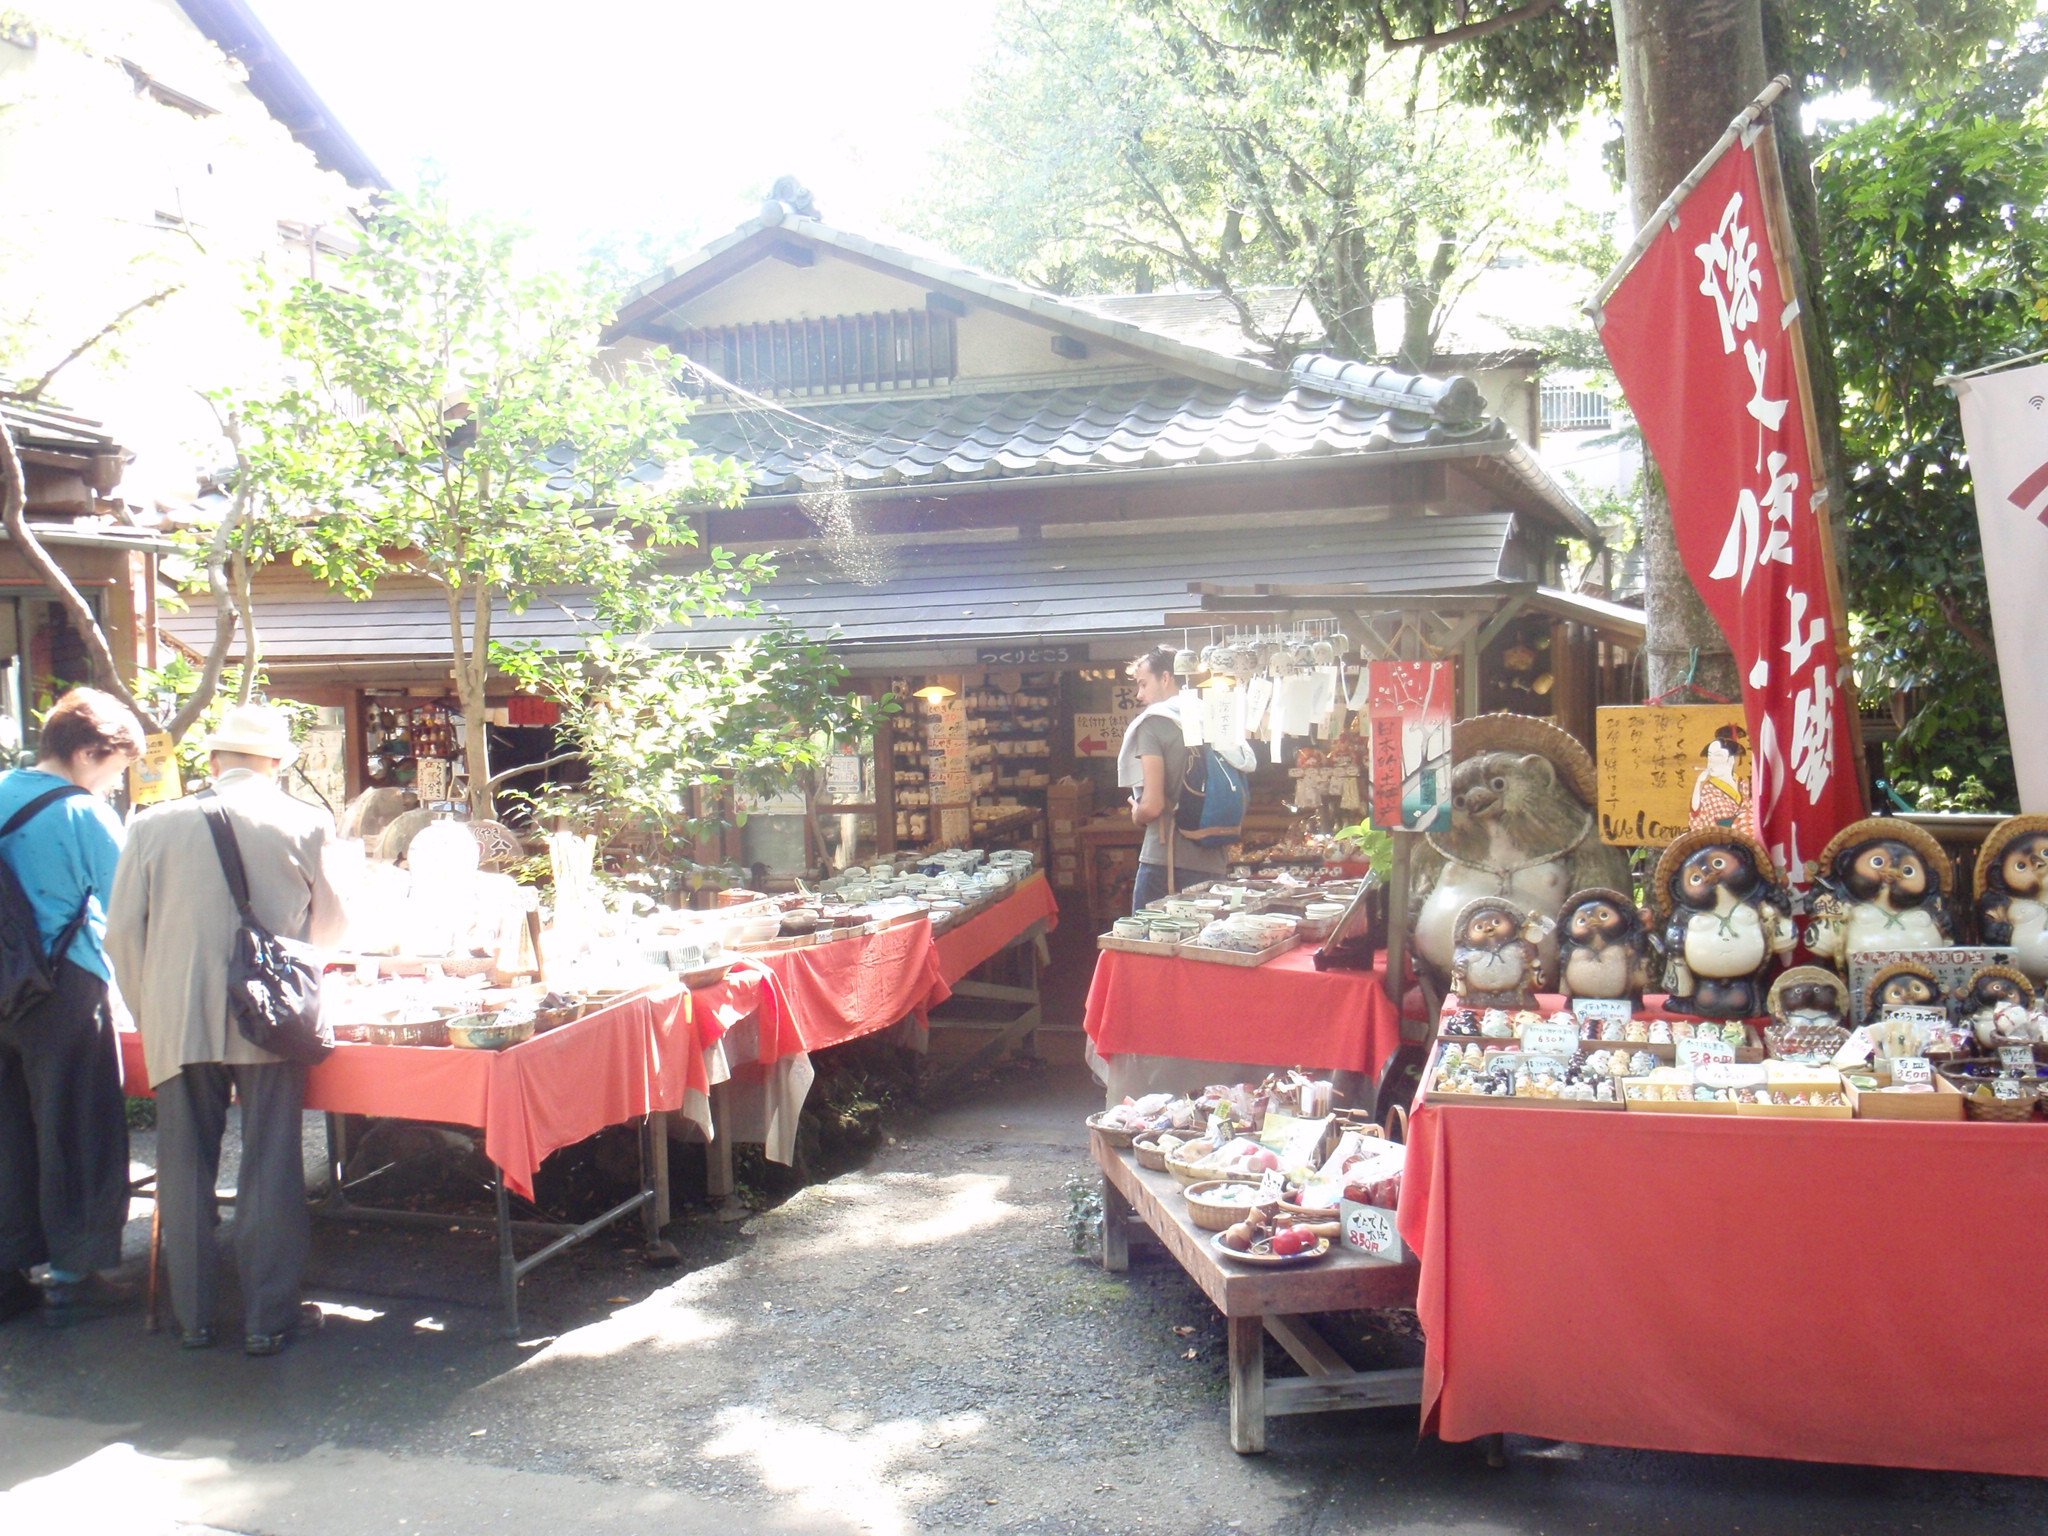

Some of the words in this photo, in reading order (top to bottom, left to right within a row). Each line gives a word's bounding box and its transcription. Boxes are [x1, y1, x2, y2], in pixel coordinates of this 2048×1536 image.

[982, 648, 1069, 663] つくりどころ
[1672, 713, 1688, 789] らくやき
[1689, 1051, 1732, 1064] 380円
[1896, 1068, 1929, 1080] 350円
[1350, 1230, 1379, 1251] 850円
